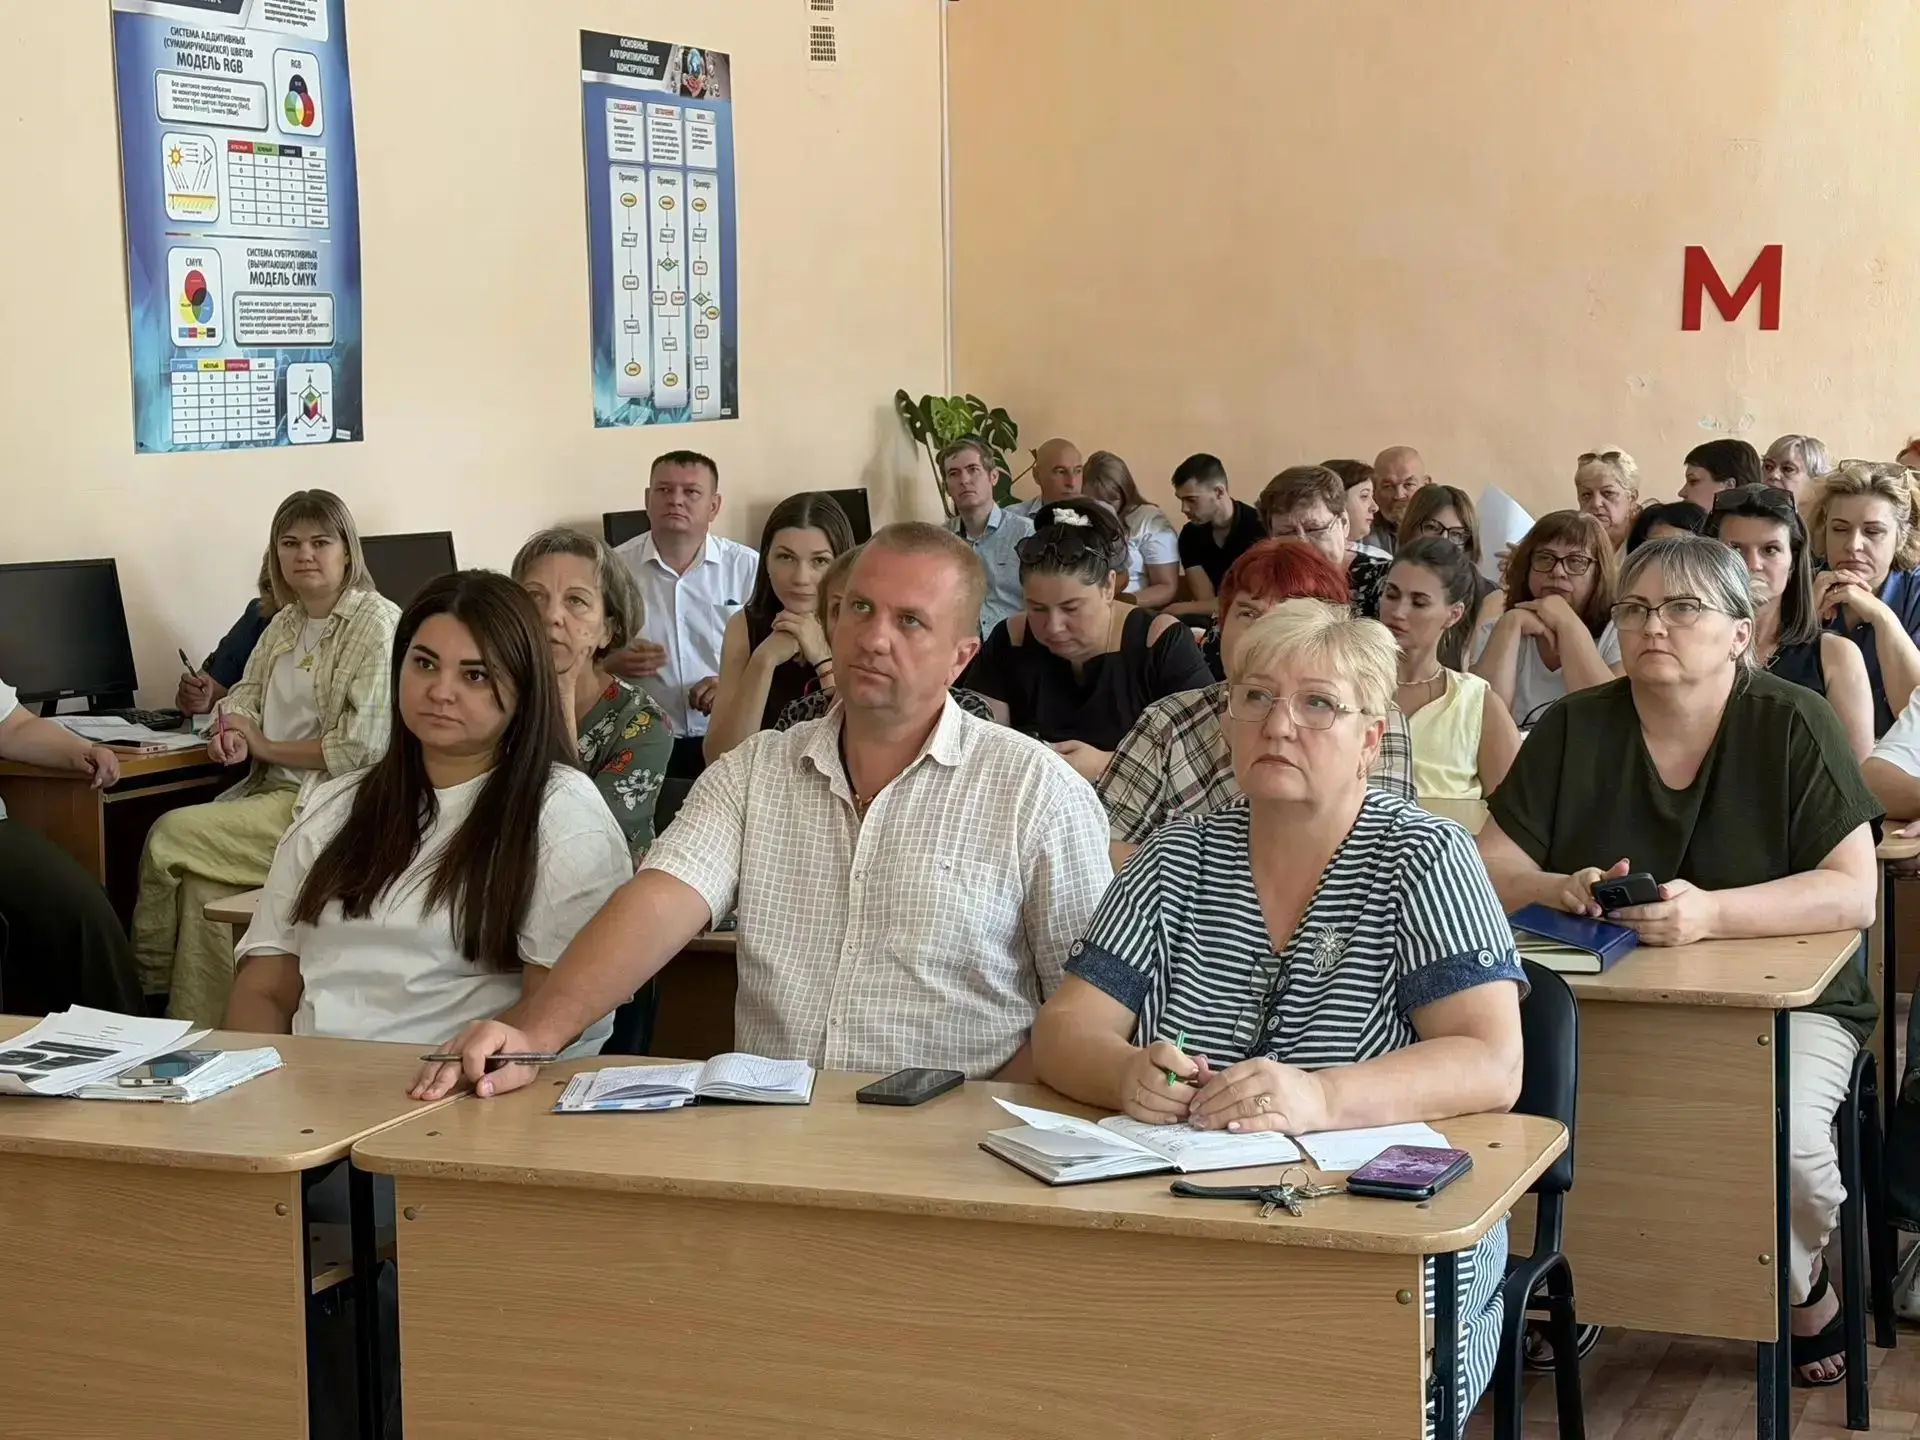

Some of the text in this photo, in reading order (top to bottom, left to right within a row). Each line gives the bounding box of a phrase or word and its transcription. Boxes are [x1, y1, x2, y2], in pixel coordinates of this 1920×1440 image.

[170, 27, 246, 45] СИСТЕМА АДДИТИВНЫХ
[164, 37, 253, 58] (СУММИРУЮЩИХСЯ) ЦВЕТОВ
[620, 38, 648, 50] ОСНОВНЫЕ
[177, 52, 243, 73] МОДЕЛЬ RGB
[610, 49, 660, 65] АЛГОРИТМИЧЕСКИЕ
[616, 63, 654, 76] КОНСТРУКЦИИ
[247, 248, 317, 259] СИСТЕМА СУБТРАТИВНЫХ
[185, 258, 203, 267] CMYK
[248, 259, 317, 270] (ВЫЧИТАЮЩИХ) ЦВЕТОВ
[250, 272, 290, 287] МОДЕЛЬ
